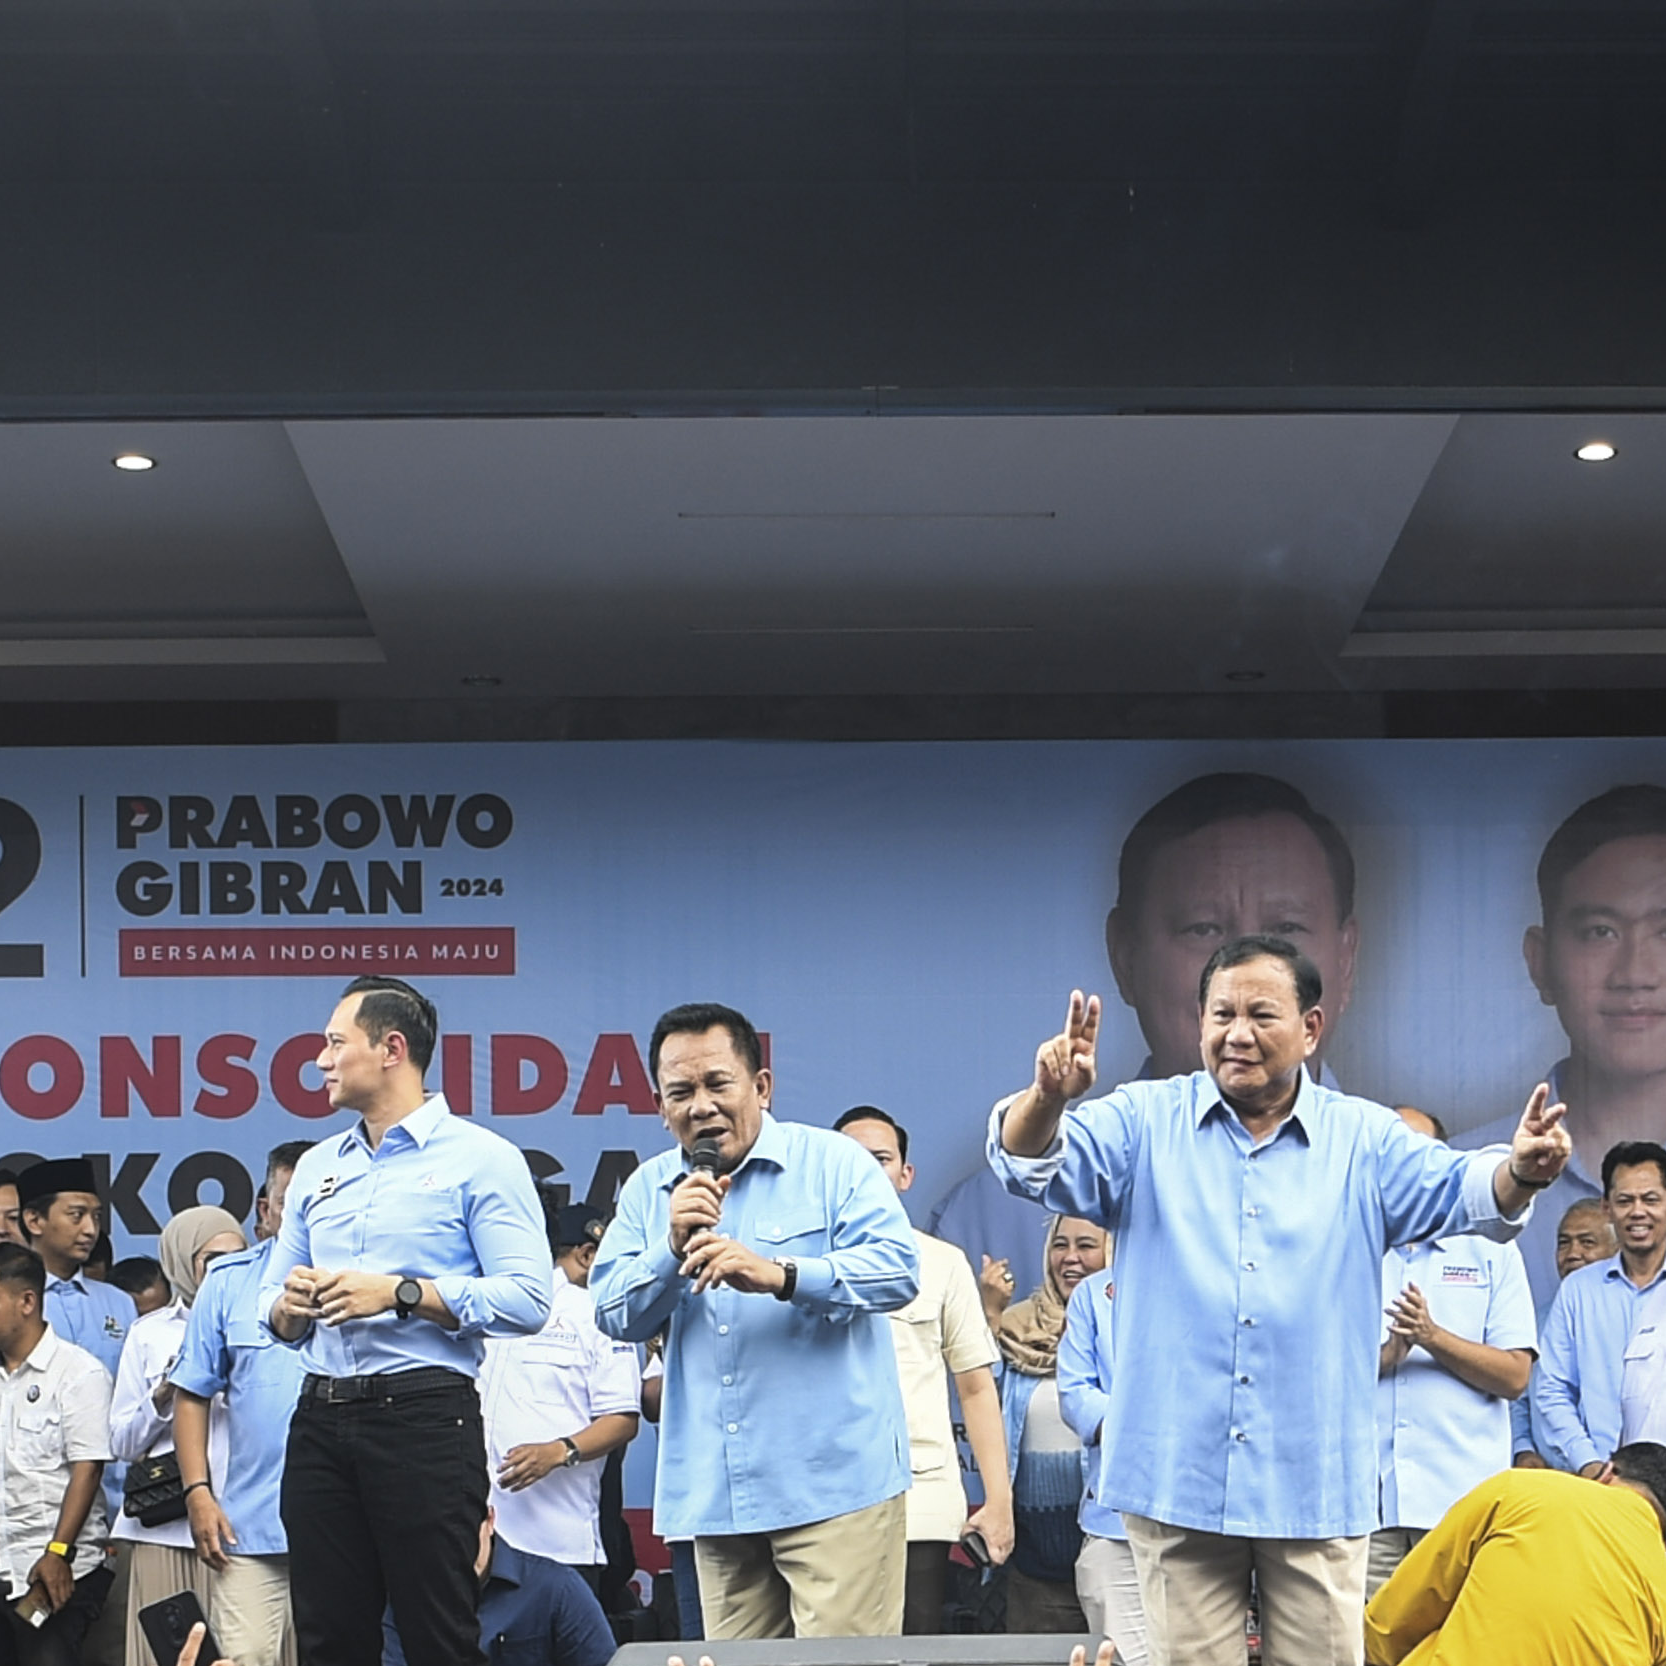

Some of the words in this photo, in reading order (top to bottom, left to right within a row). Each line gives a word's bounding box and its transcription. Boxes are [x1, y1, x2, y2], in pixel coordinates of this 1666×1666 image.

[116, 794, 514, 850] PRABOWO
[116, 860, 423, 917] GIBRAN
[439, 878, 504, 897] 2024
[133, 945, 256, 961] BERSAMA
[269, 944, 419, 961] INDONESIA
[432, 943, 500, 960] MAJU
